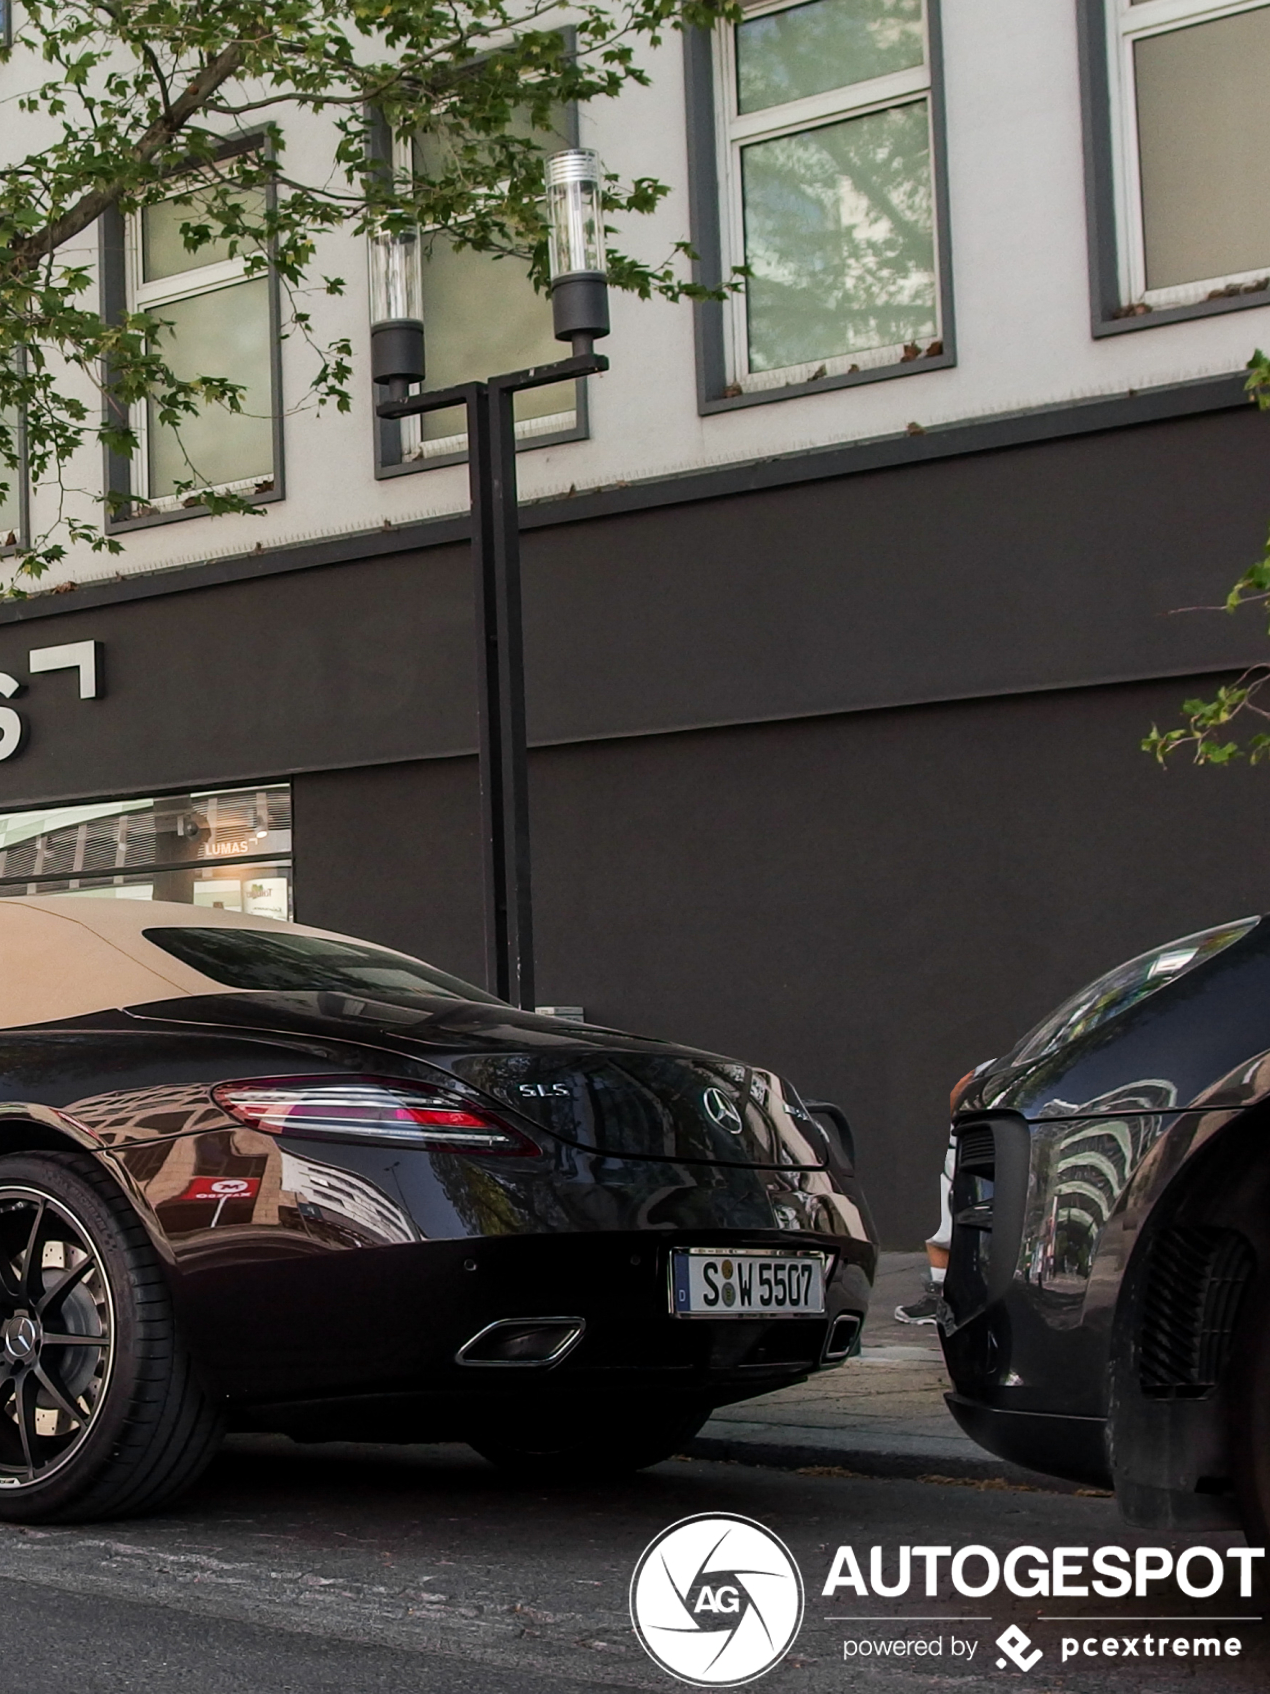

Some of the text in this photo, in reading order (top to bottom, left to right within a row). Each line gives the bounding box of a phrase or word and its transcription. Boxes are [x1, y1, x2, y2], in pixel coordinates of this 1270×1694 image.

[205, 841, 249, 856] LUMAS
[519, 1083, 570, 1097] SLS
[758, 1263, 813, 1307] 5507
[679, 1289, 686, 1302] D
